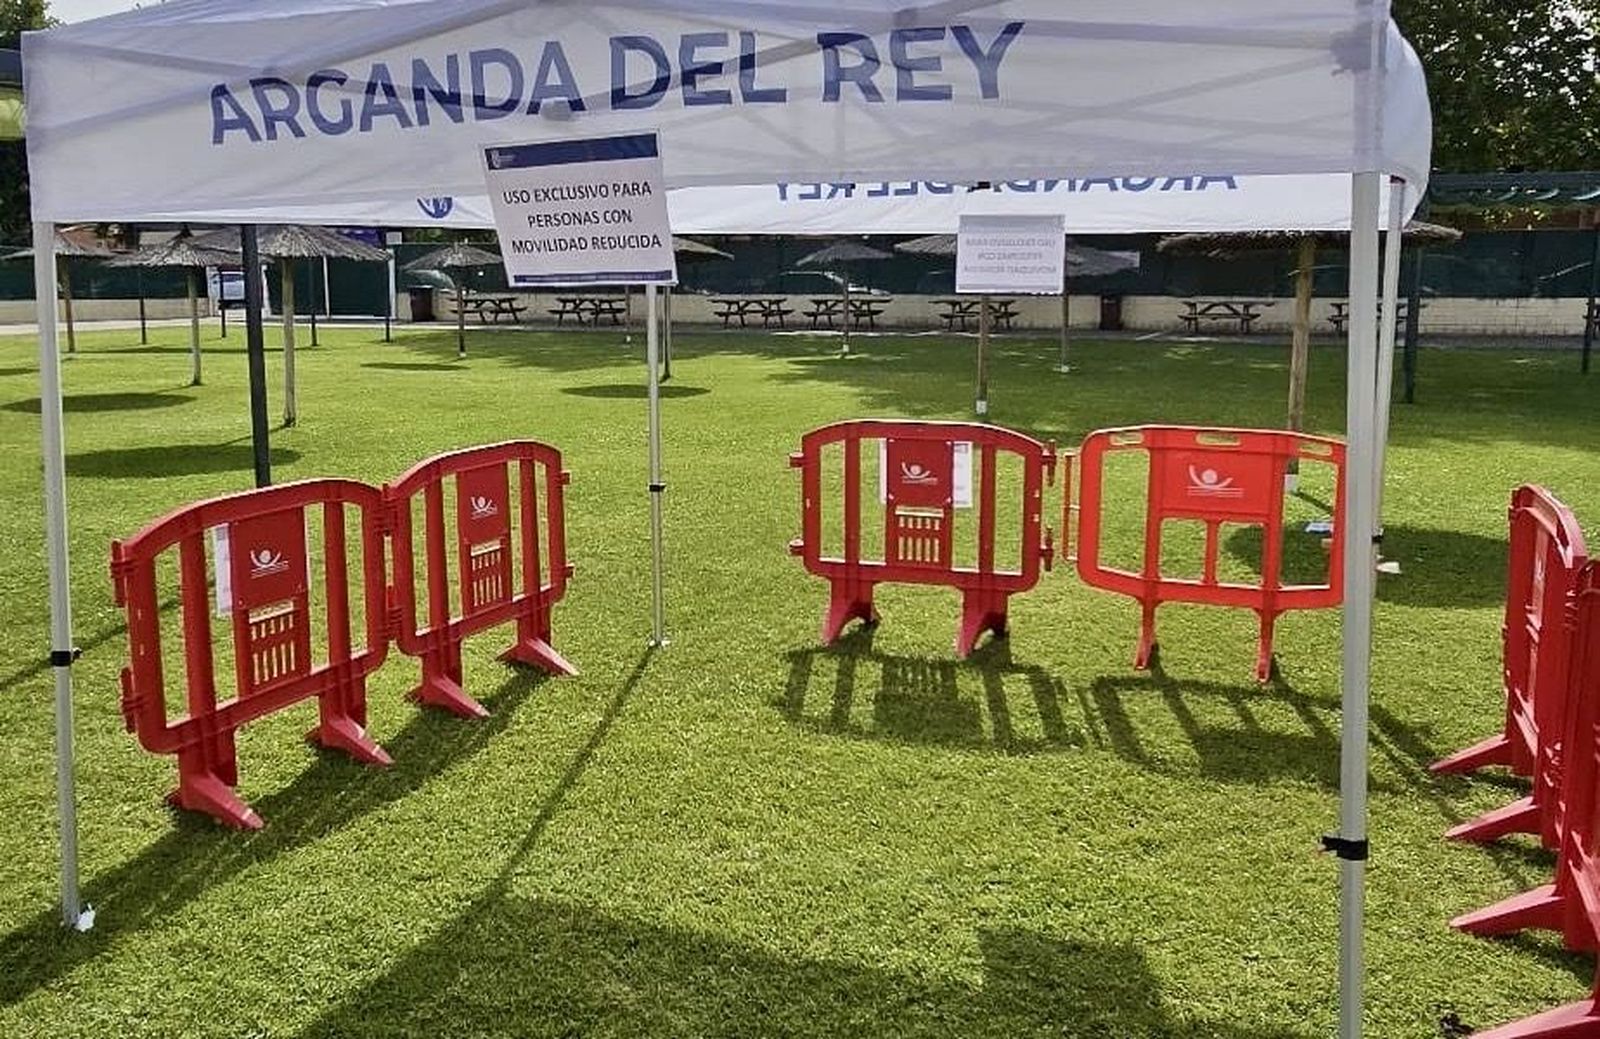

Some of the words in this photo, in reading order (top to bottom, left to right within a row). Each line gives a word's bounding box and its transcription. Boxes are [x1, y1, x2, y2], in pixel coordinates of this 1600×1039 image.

[210, 41, 587, 144] ARGANDA
[608, 31, 787, 110] DEL
[816, 22, 1026, 102] REY
[503, 189, 531, 204] USO
[534, 184, 610, 203] EXCLUSIVO
[613, 181, 652, 197] PARA
[527, 210, 601, 228] PERSONAS
[603, 209, 633, 224] CON
[511, 236, 588, 254] MOVILIDAD
[591, 234, 662, 251] REDUCIDA
